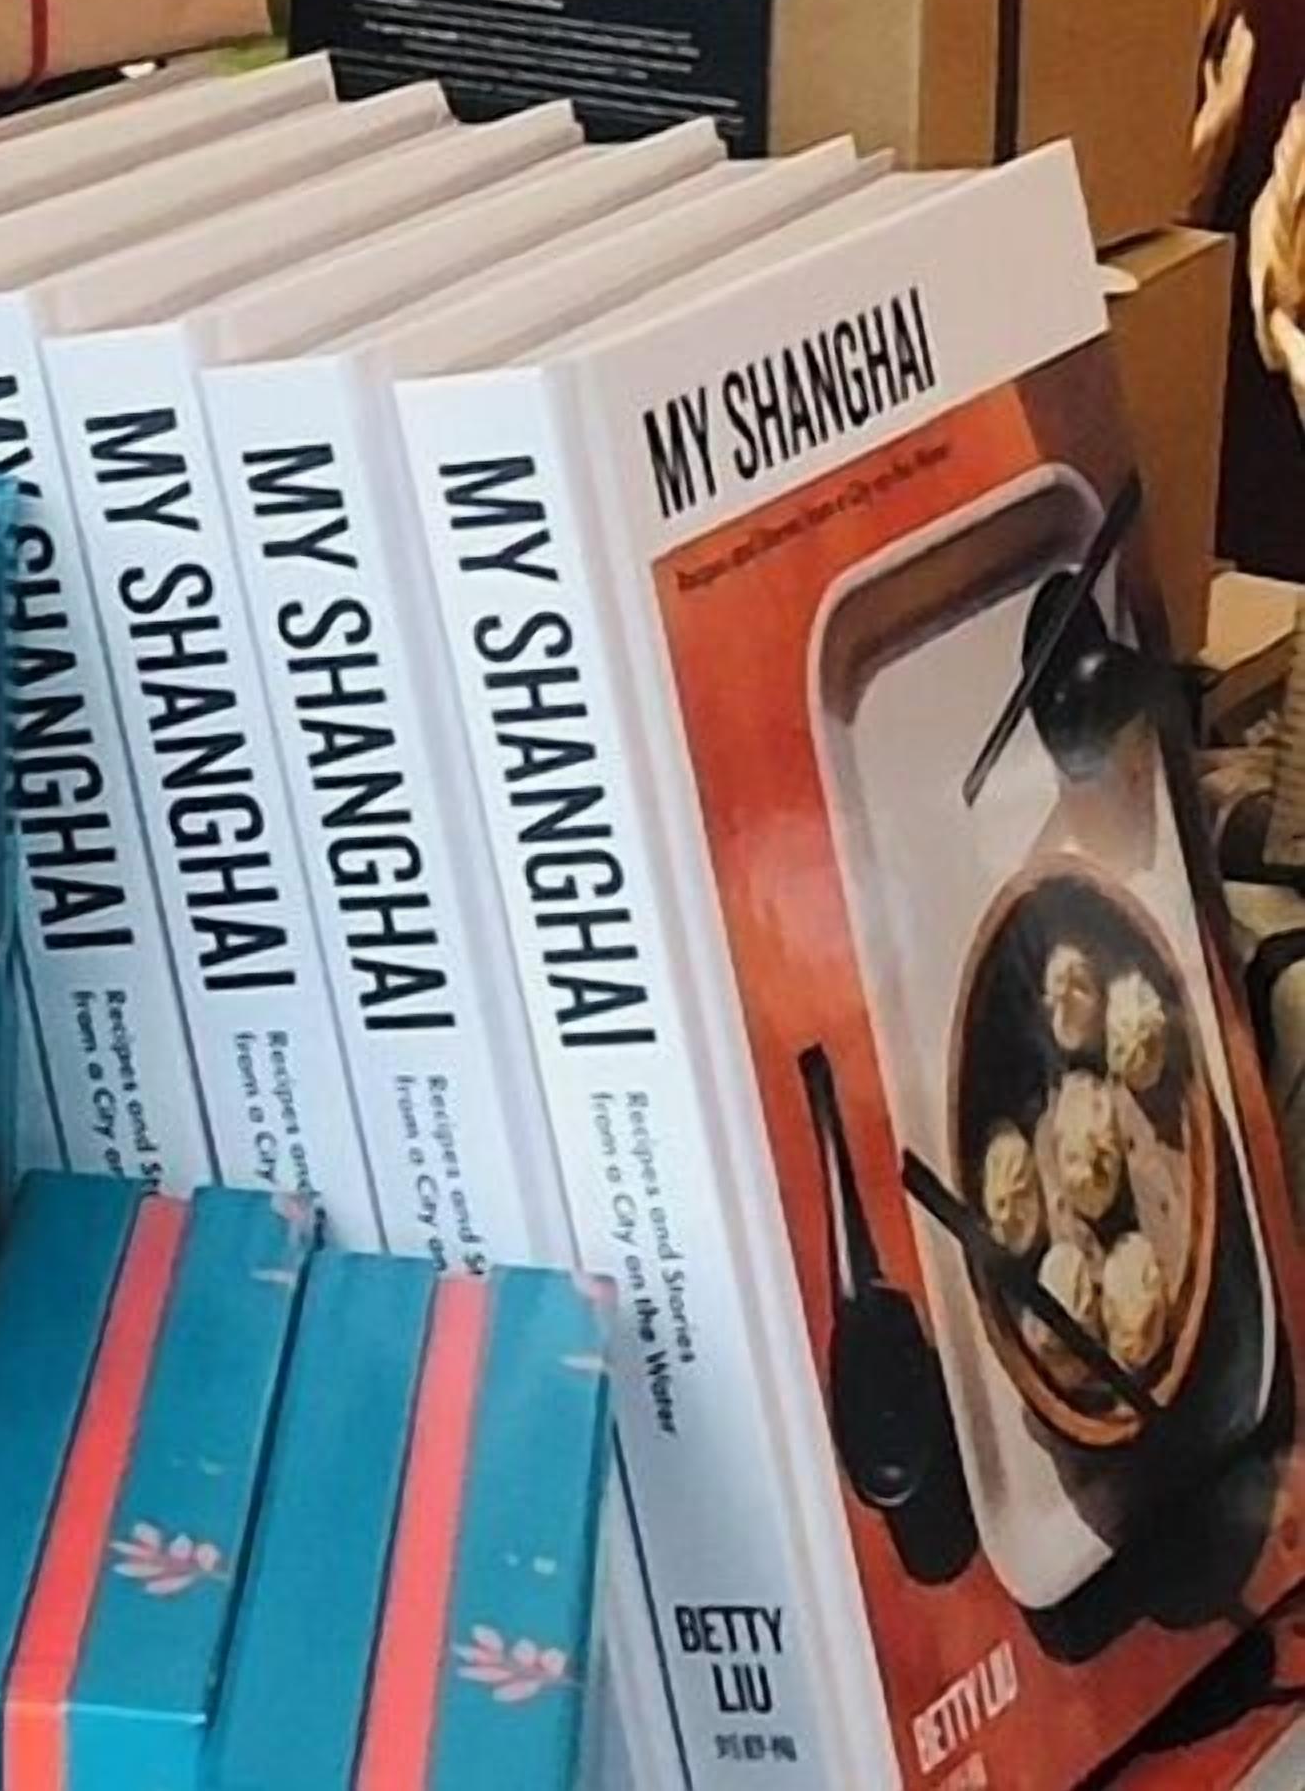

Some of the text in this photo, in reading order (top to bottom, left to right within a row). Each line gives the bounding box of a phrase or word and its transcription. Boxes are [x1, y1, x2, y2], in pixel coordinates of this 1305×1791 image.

[643, 386, 717, 519] MY
[723, 287, 937, 483] SHANGHAI
[84, 408, 297, 993] MY SHANGHAI
[241, 442, 456, 1032] MY SHANGHAI
[439, 455, 656, 1049] MY SHANGHAI
[675, 1604, 782, 1654] BETTY
[711, 1663, 773, 1713] LIU
[913, 1669, 982, 1775] BETTY
